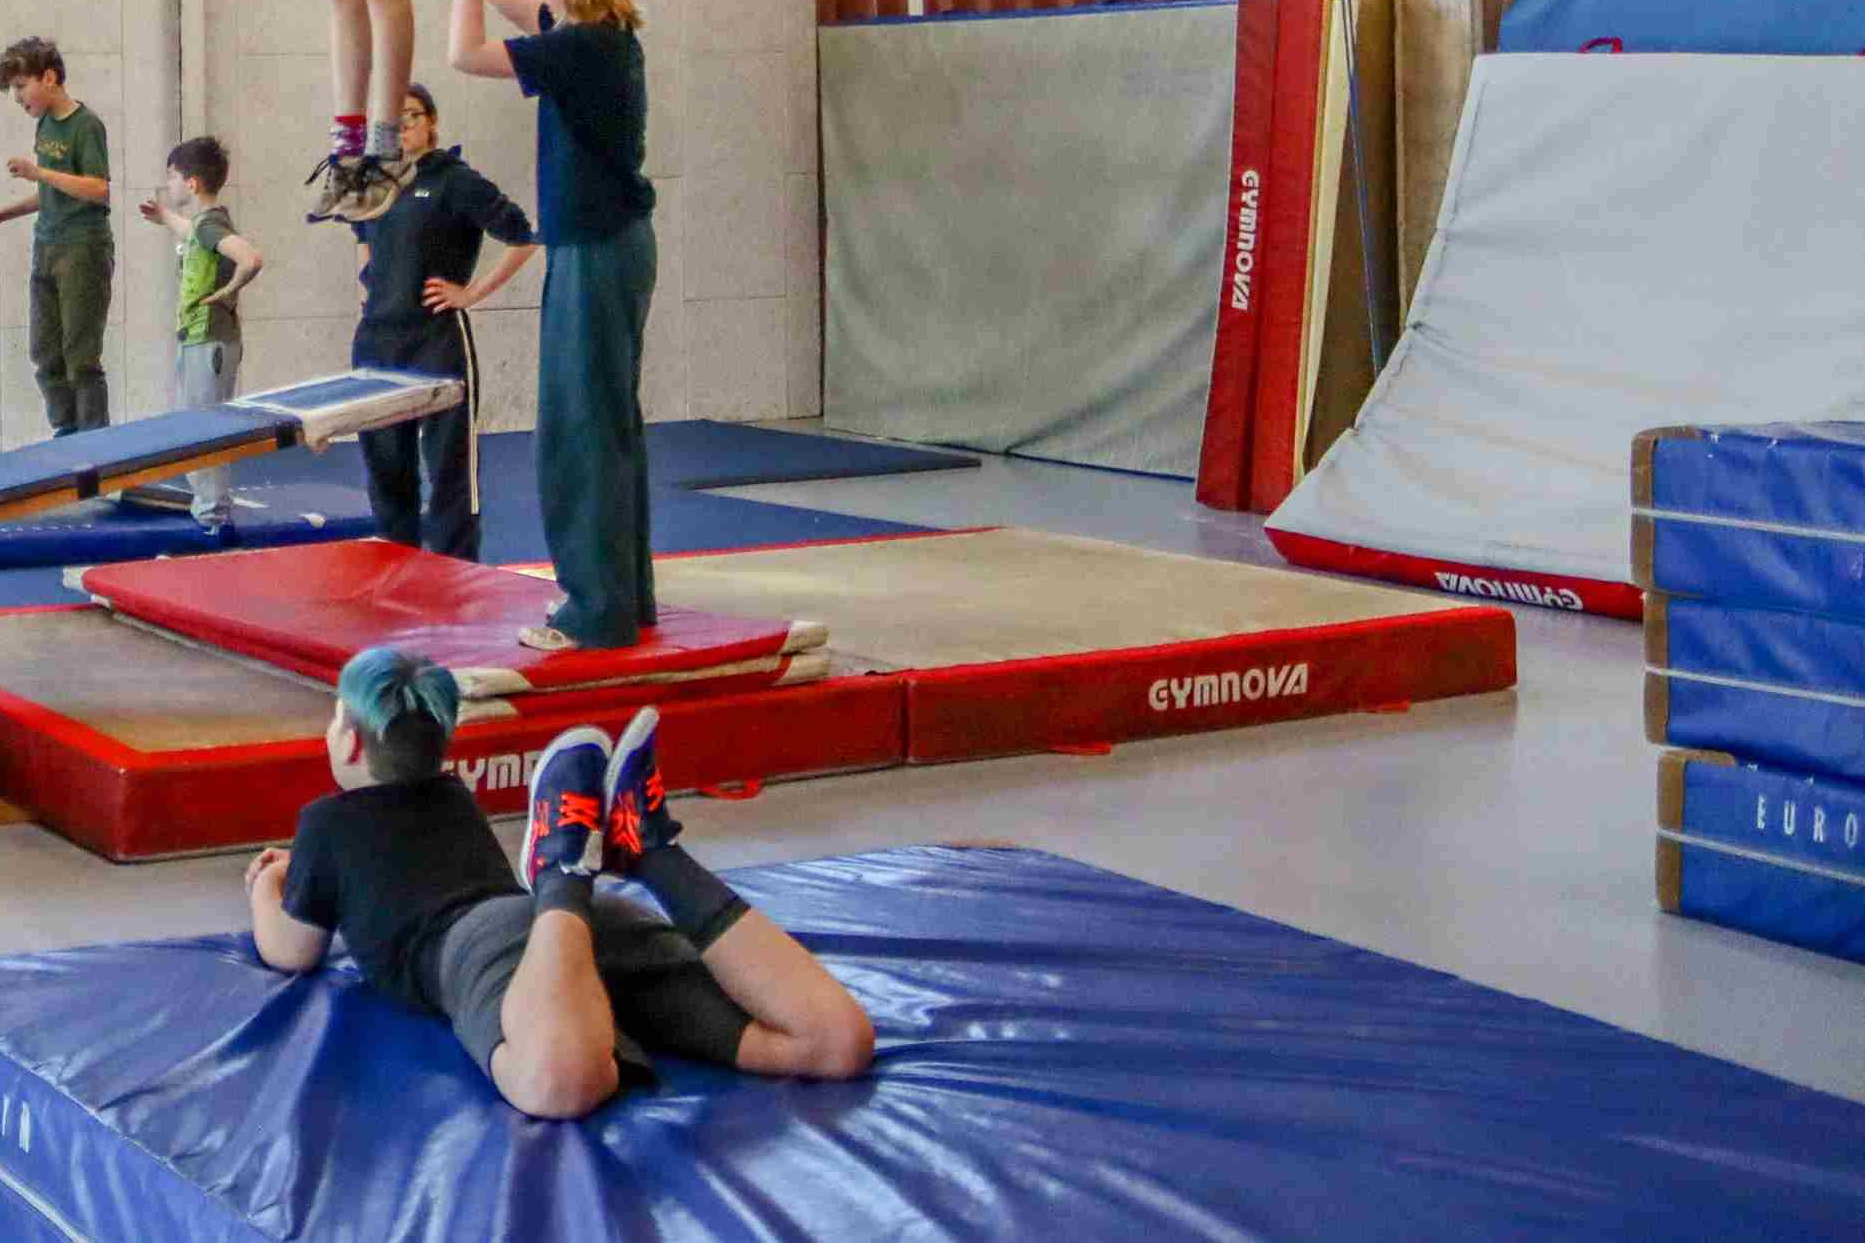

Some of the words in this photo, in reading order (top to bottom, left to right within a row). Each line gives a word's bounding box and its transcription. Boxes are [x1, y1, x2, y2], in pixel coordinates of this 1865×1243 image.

[1231, 169, 1260, 311] GYMNOVA
[1148, 662, 1310, 712] GYMNOVA
[1755, 792, 1859, 849] EURO
